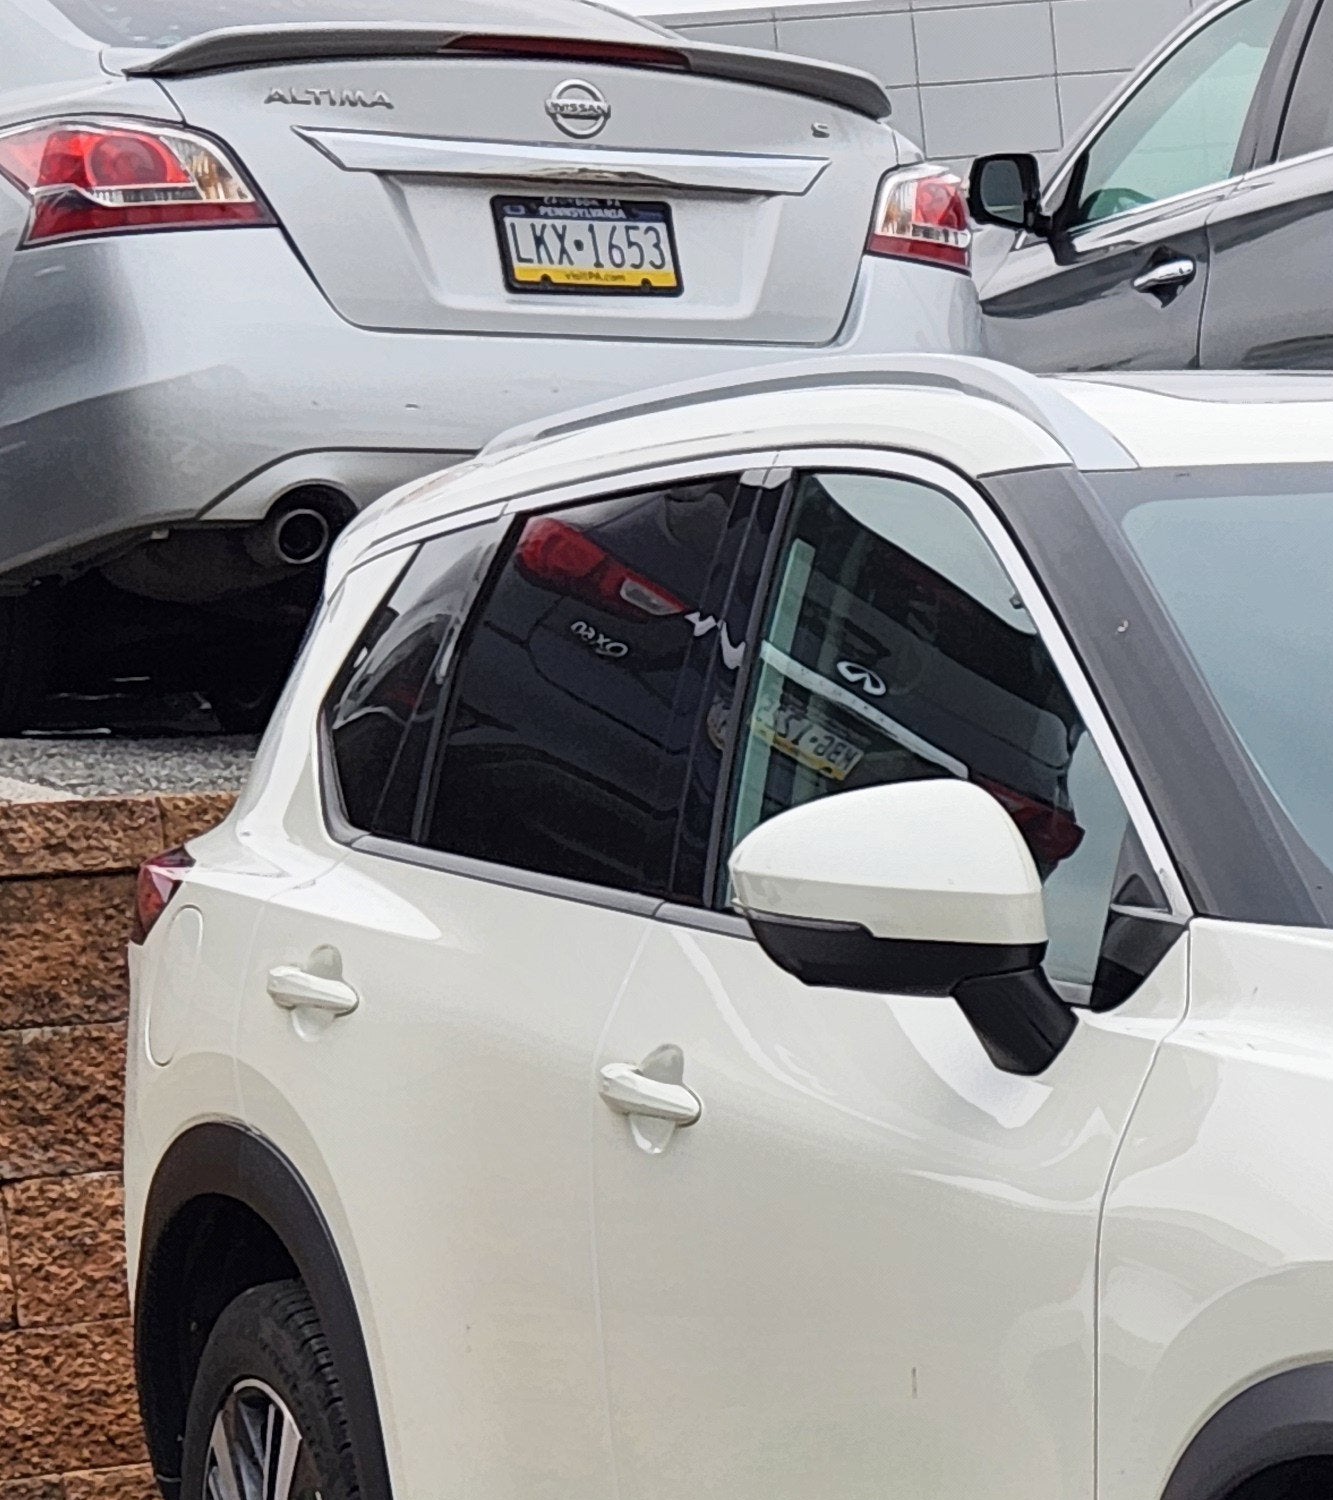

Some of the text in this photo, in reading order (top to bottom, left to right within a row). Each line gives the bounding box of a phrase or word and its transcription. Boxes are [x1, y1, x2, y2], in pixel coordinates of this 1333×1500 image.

[264, 87, 394, 109] ALTIMA
[550, 101, 606, 116] NISSAN
[811, 122, 830, 139] S
[538, 205, 627, 219] PENNSYLVANIA
